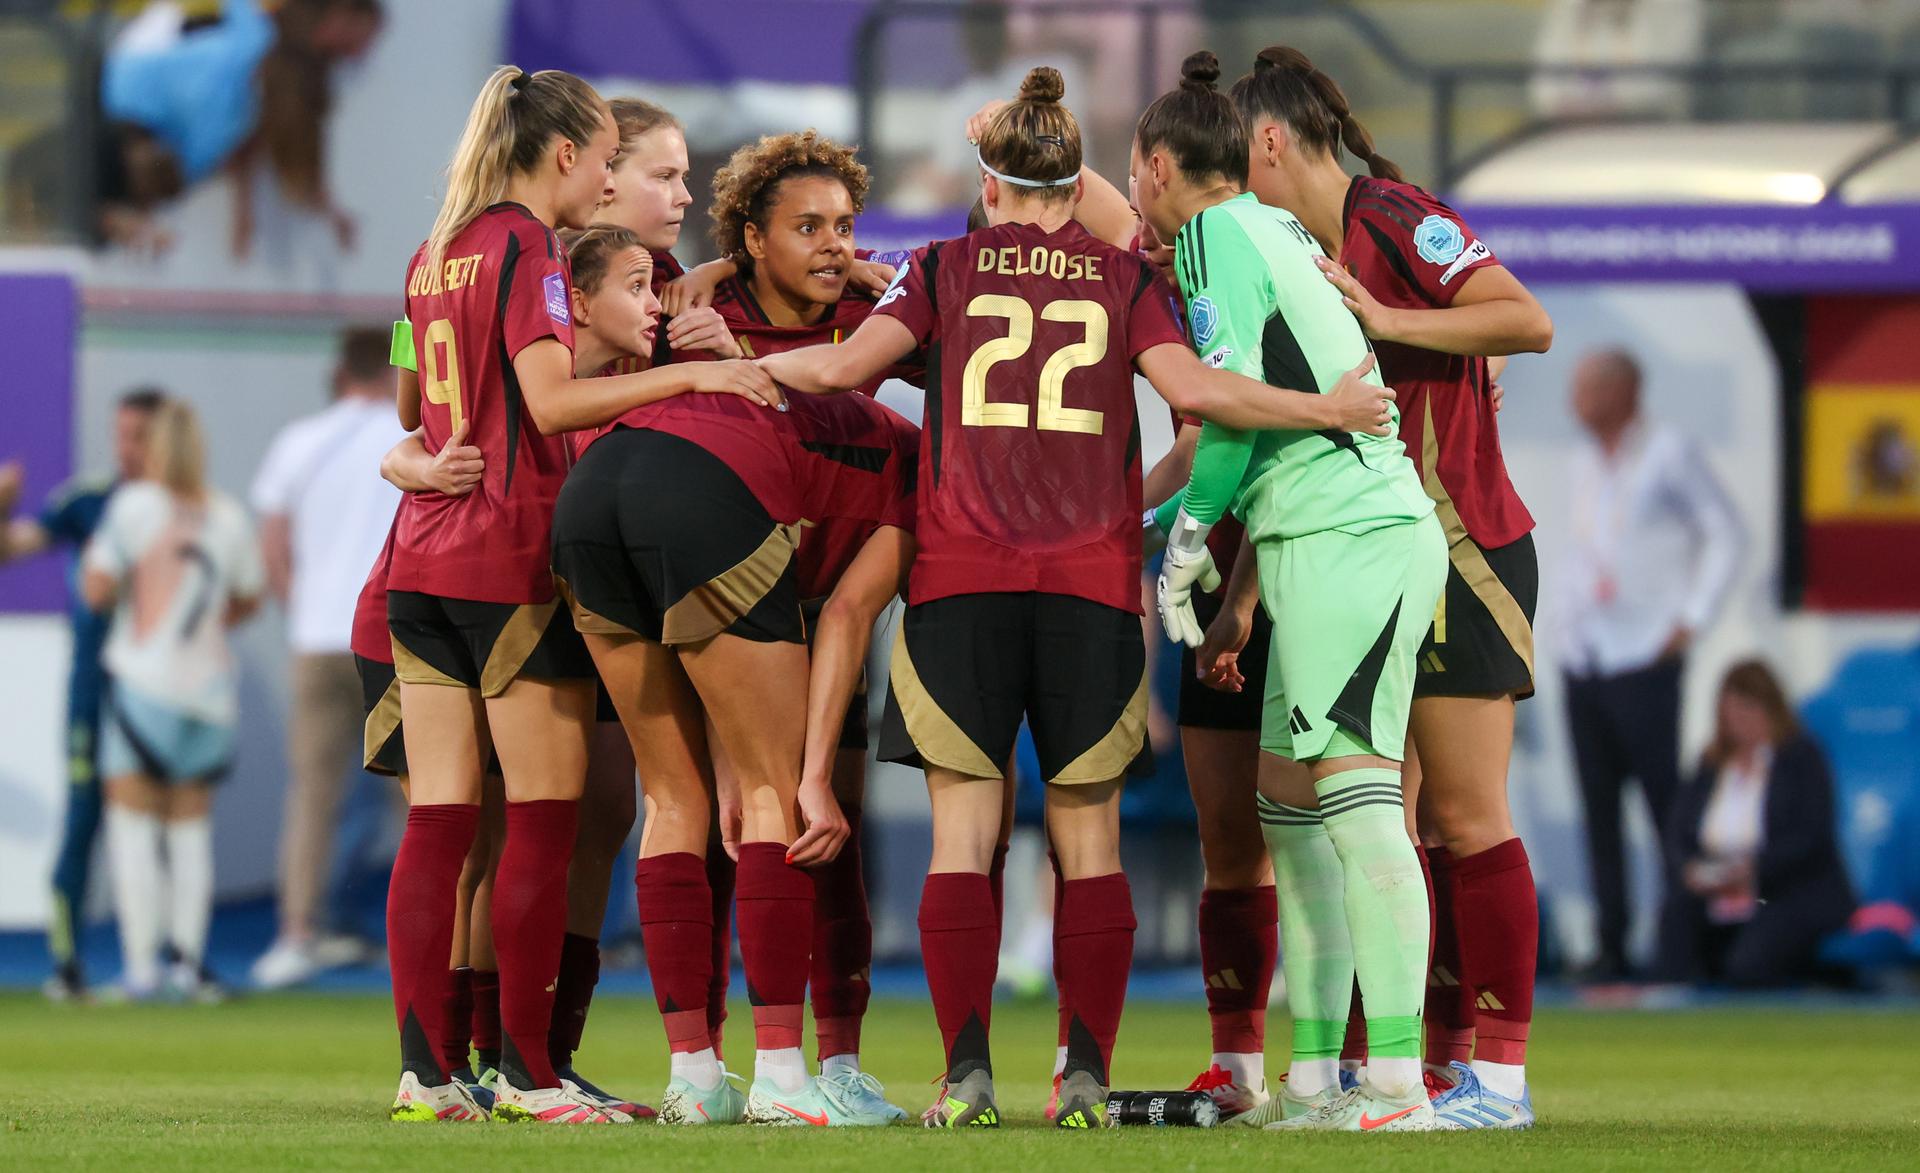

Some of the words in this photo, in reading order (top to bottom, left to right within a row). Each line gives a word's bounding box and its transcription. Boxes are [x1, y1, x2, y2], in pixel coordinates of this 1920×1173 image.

[408, 254, 484, 298] WULAERT
[977, 244, 1103, 281] DELOOSE
[424, 319, 464, 438] 9
[962, 293, 1109, 436] 22
